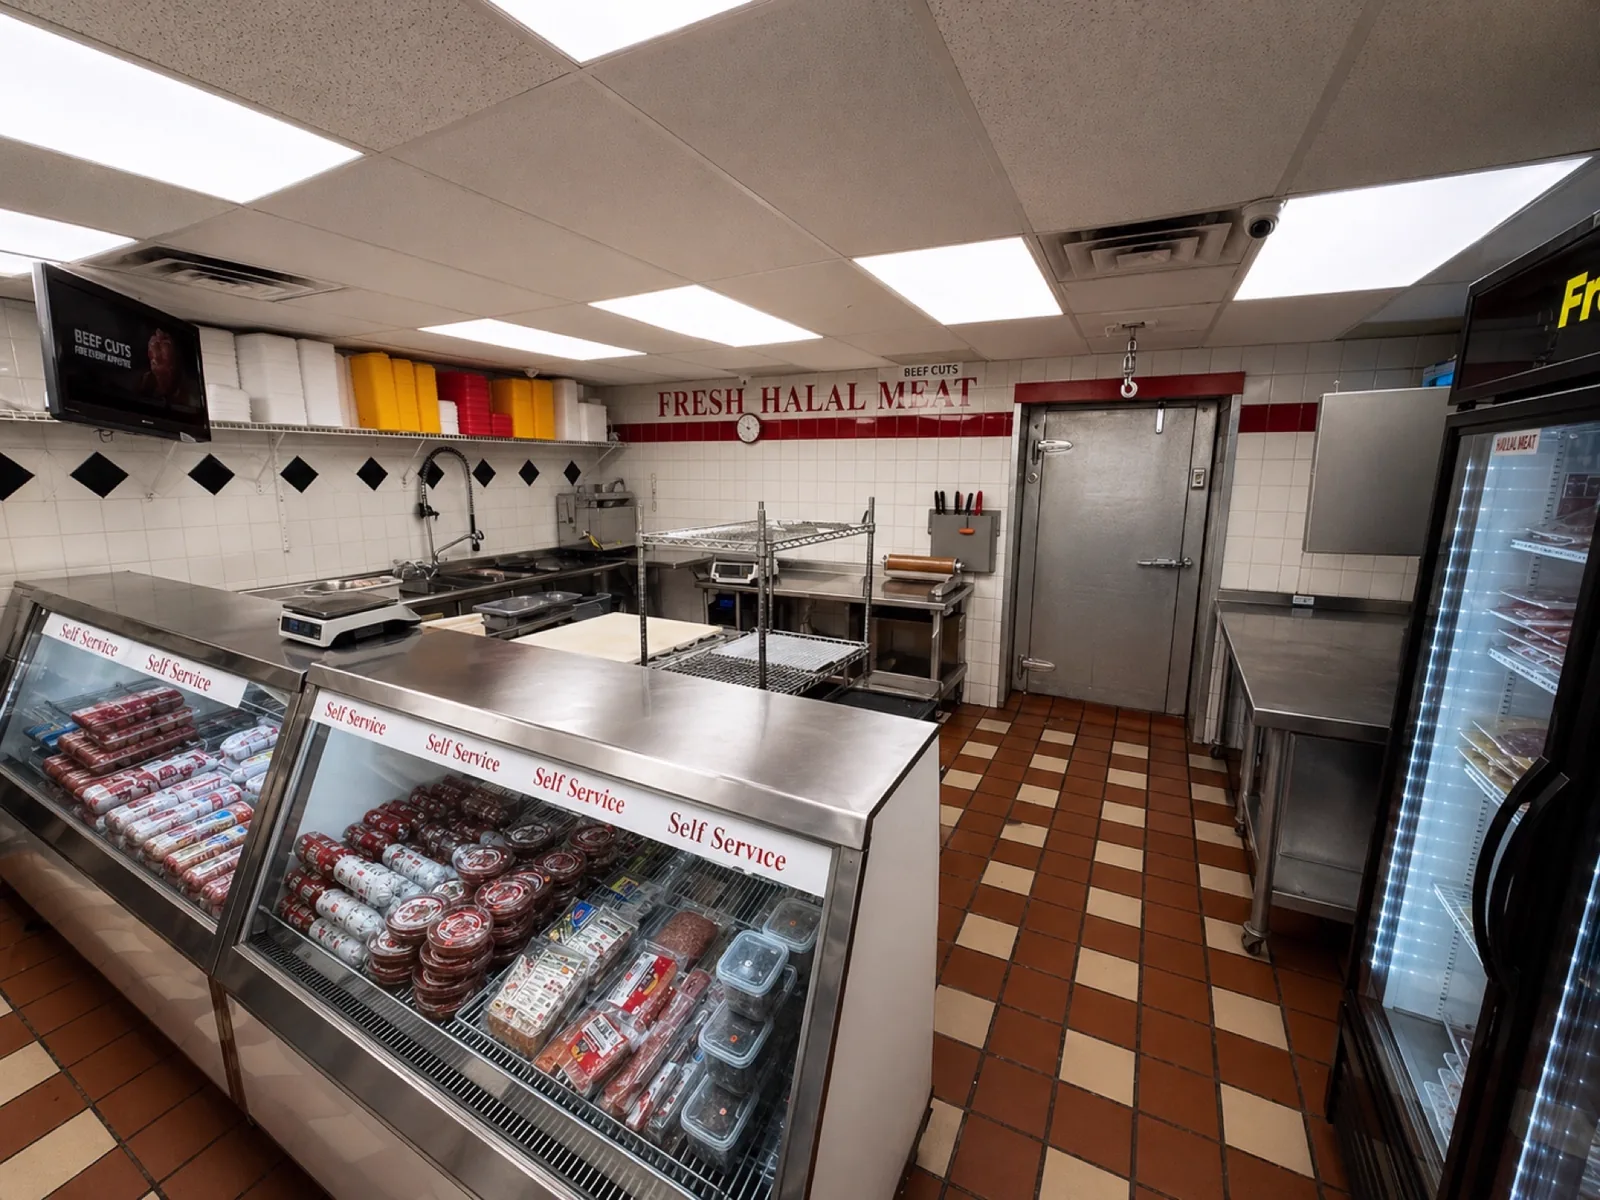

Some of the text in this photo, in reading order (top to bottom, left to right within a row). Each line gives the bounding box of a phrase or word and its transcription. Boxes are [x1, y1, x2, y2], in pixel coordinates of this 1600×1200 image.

[1557, 271, 1600, 329] Fr
[74, 328, 132, 358] BEEF CUTS
[904, 364, 959, 377] BEEF CUTS
[658, 377, 978, 417] FRESH HALAL MEAT
[59, 622, 119, 657] Self Service
[145, 653, 212, 692] Self Service
[324, 701, 387, 736] Self Service
[425, 733, 501, 773] Self Service
[532, 766, 626, 815] Self Service
[667, 811, 788, 872] Self Service
